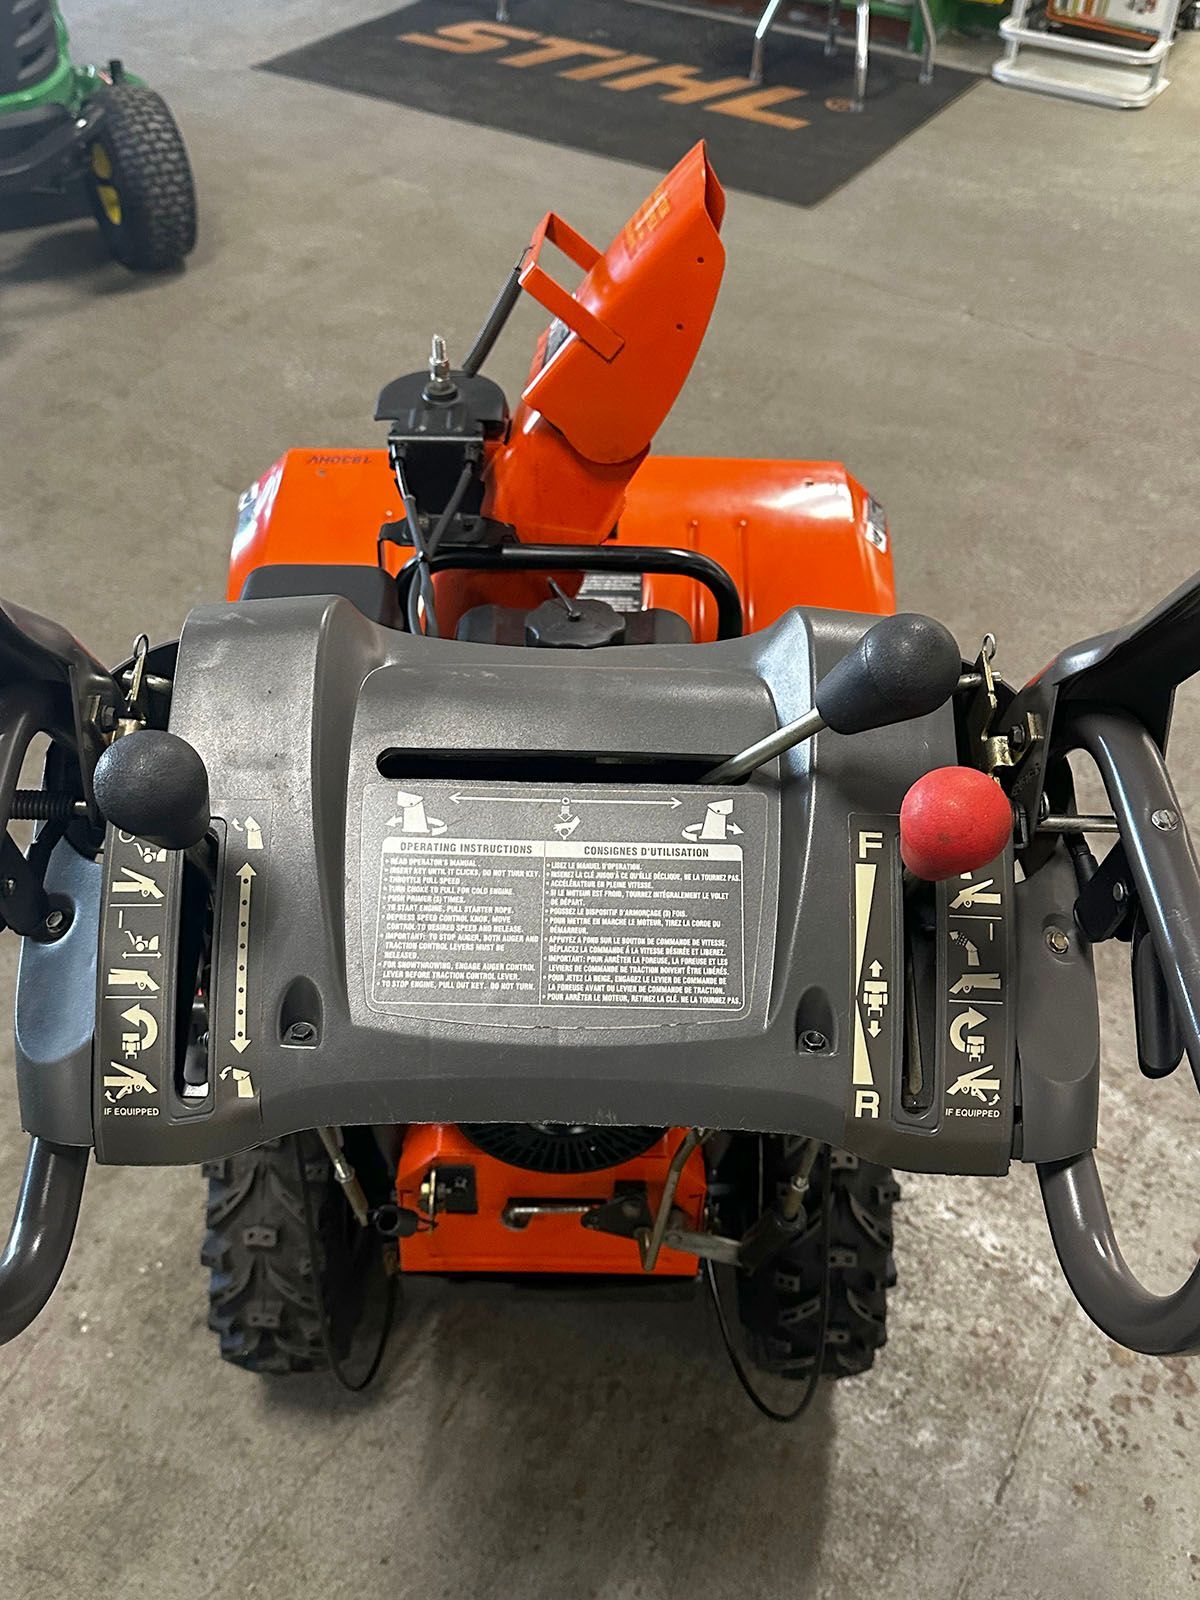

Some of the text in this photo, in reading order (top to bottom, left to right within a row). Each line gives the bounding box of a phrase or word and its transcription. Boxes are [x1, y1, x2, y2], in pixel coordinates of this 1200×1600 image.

[396, 20, 811, 130] STIHL
[400, 842, 532, 855] OPERATING INSTRUCTIONS
[584, 846, 709, 858] CONSIGNES D'UTILISATION
[858, 832, 883, 859] F
[854, 1090, 880, 1119] R
[104, 1107, 159, 1117] IF EQUIPPED
[945, 1107, 1000, 1119] IF EQUIPPED
